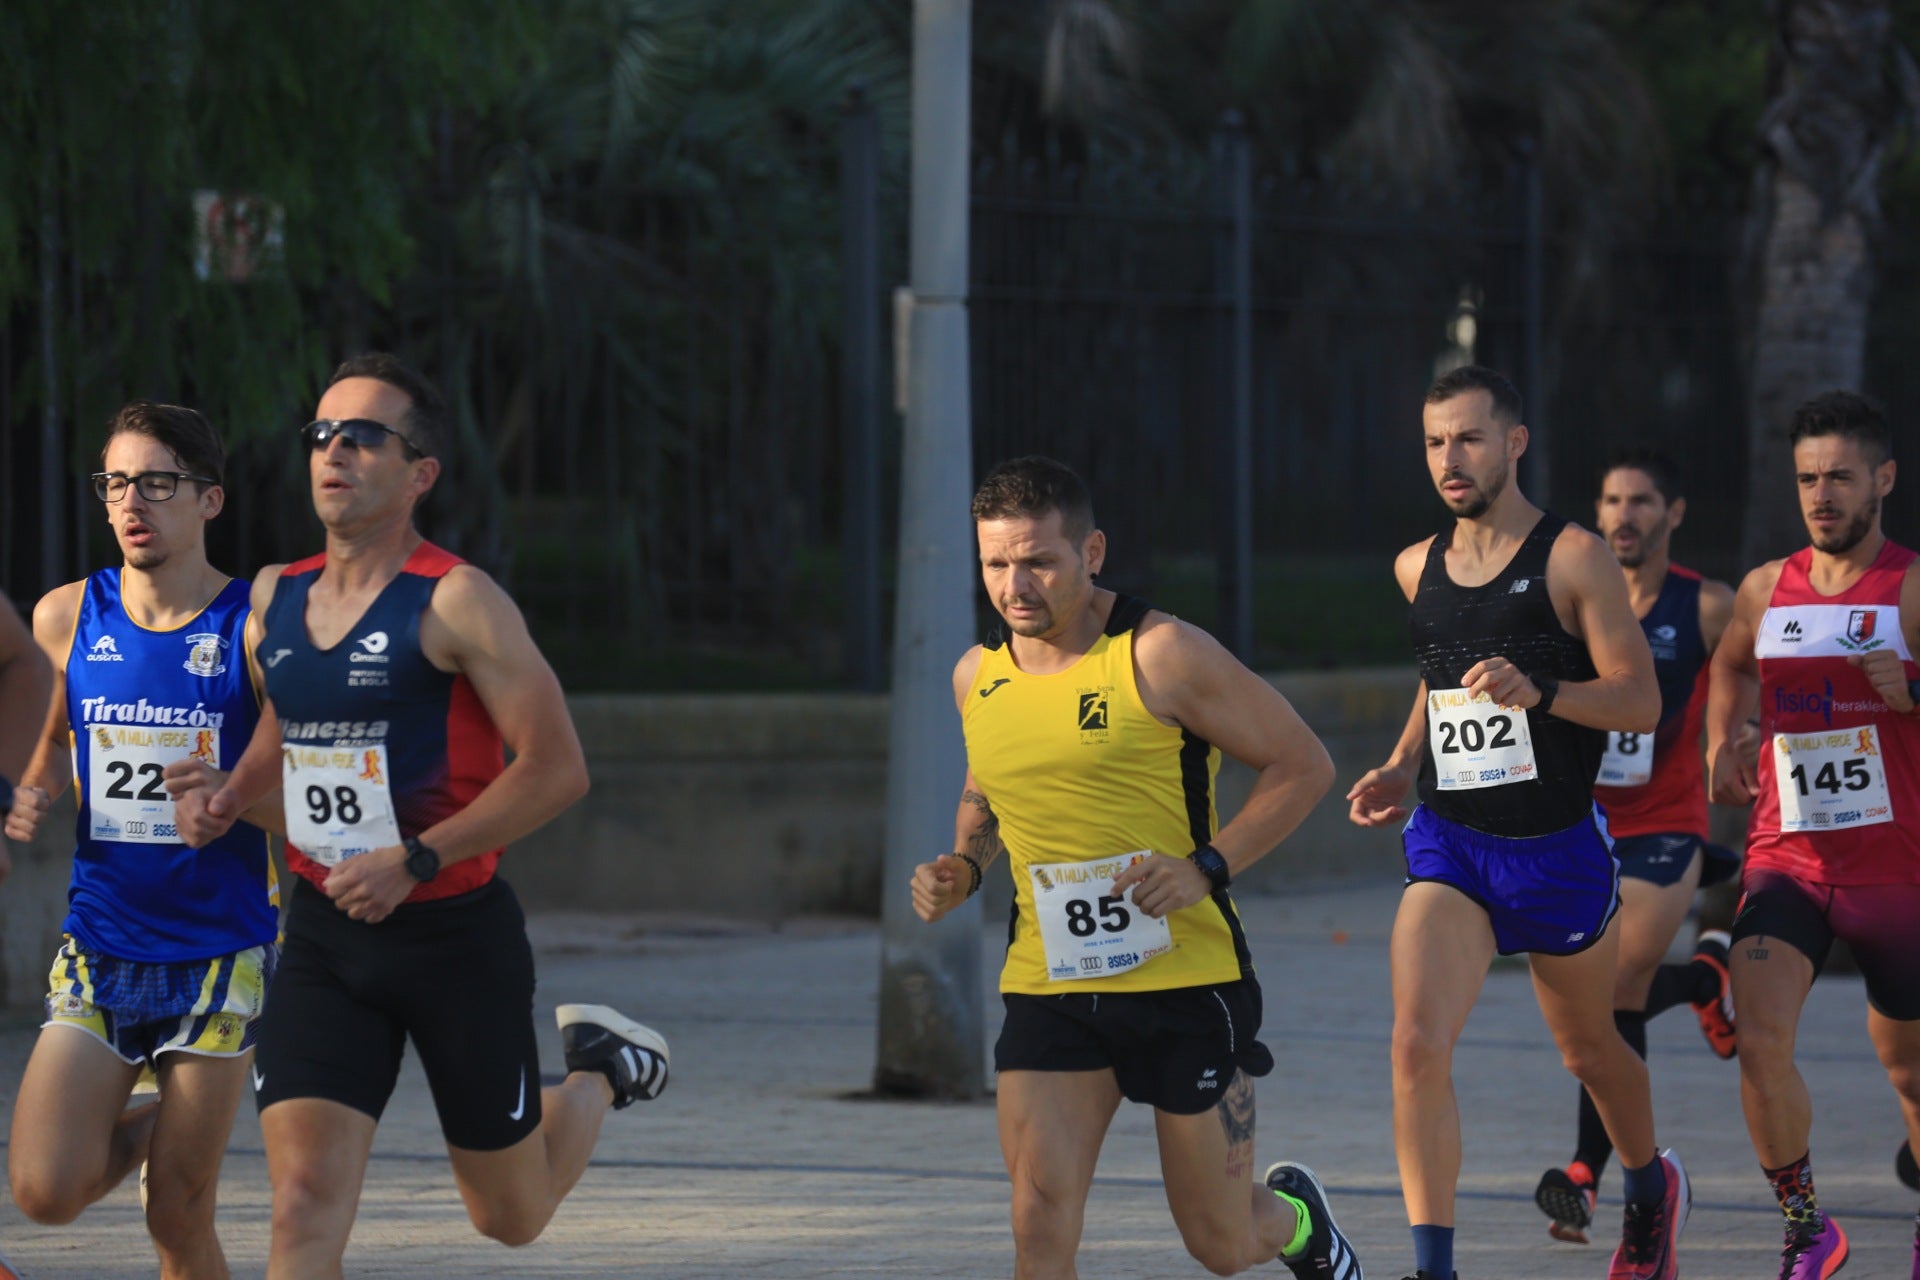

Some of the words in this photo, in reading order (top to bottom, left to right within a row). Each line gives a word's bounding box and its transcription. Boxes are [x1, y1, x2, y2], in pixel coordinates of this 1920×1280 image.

[86, 653, 124, 662] austral
[81, 696, 224, 730] Tirabuzón
[1775, 687, 1822, 713] fisio
[1833, 700, 1889, 713] herakles
[128, 730, 154, 747] MILLA
[156, 732, 189, 748] VERDE
[1439, 714, 1517, 754] 202
[1825, 733, 1852, 748] VERDE
[105, 761, 175, 802] 22
[1480, 768, 1501, 782] asisa
[1510, 764, 1533, 776] COVAP
[1790, 757, 1871, 796] 145
[306, 785, 362, 825] 98
[1064, 865, 1092, 884] MILLA
[1065, 894, 1131, 937] 85
[1107, 952, 1133, 969] asisa
